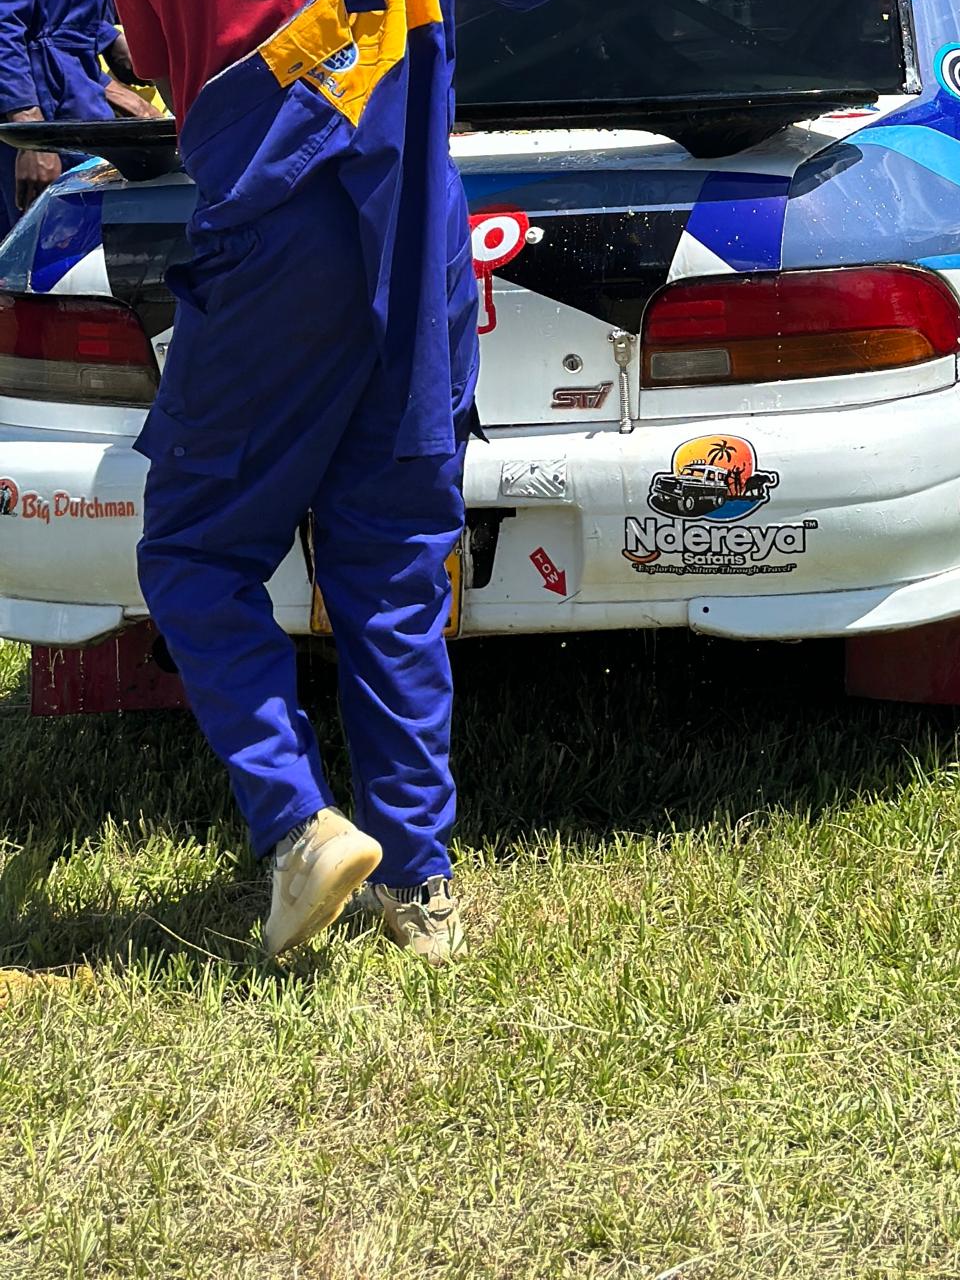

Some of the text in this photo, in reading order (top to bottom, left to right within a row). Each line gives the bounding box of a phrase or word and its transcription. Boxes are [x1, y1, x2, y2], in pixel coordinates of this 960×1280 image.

[22, 493, 136, 524] Big Dutchman
[625, 517, 806, 561] Ndereya
[535, 554, 559, 584] TOW
[683, 552, 745, 566] Safaris
